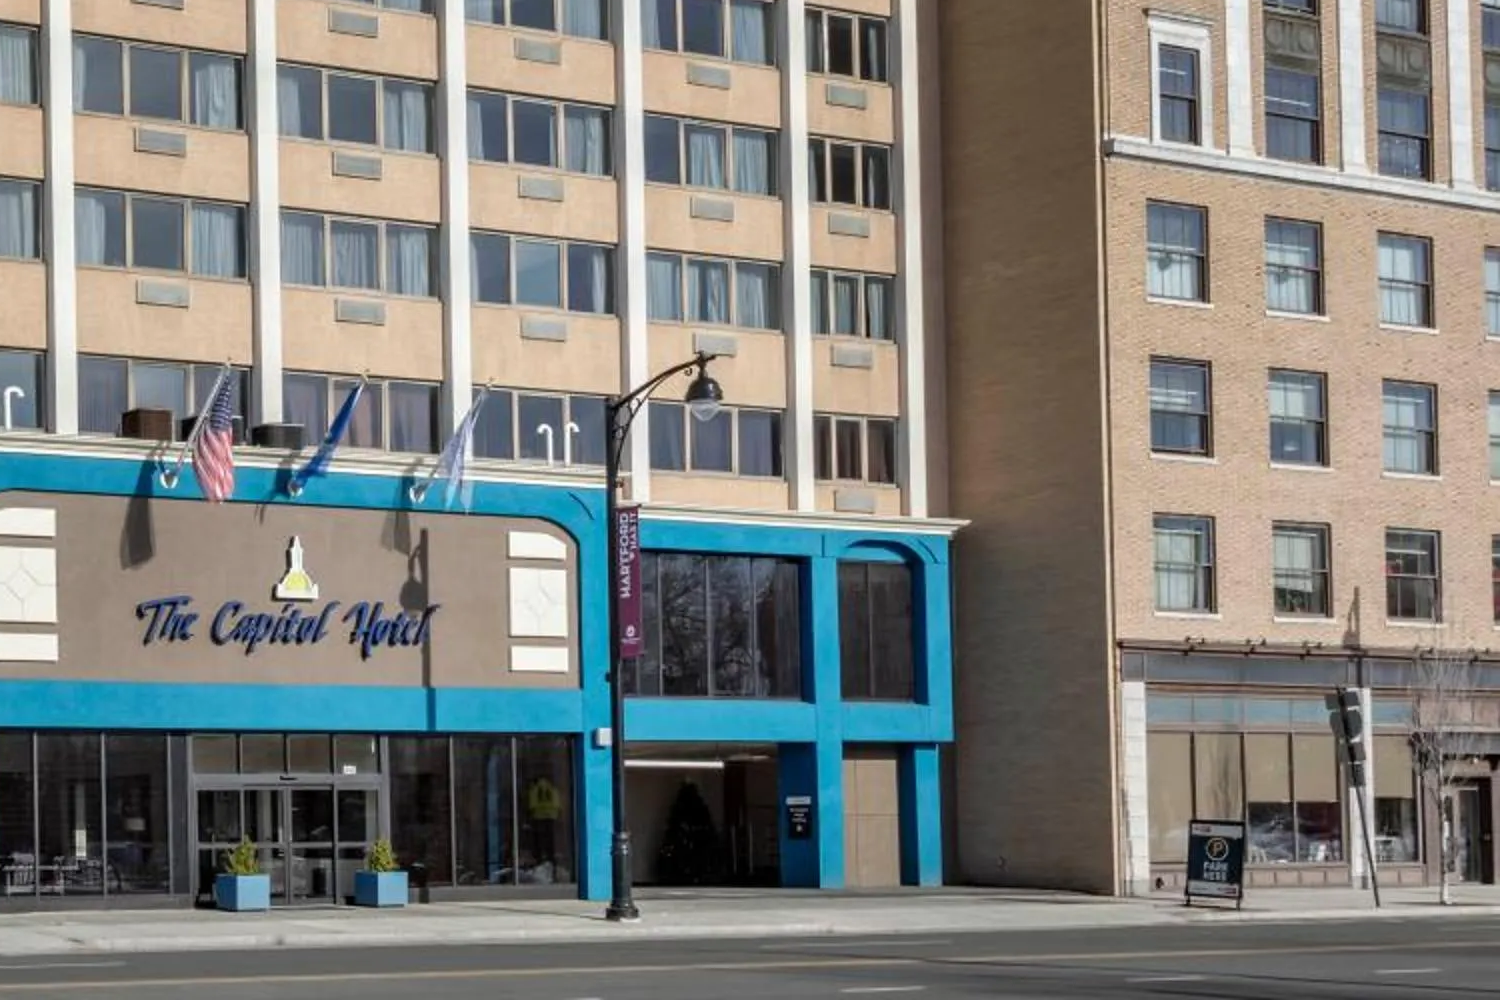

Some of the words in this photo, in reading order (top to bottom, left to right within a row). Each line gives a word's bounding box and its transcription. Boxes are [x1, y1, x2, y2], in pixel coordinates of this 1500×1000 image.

[619, 513, 631, 598] HARTFORD
[135, 595, 198, 646] The
[210, 600, 340, 656] Capitol
[342, 600, 441, 661] Hotel
[1203, 861, 1228, 872] PARK
